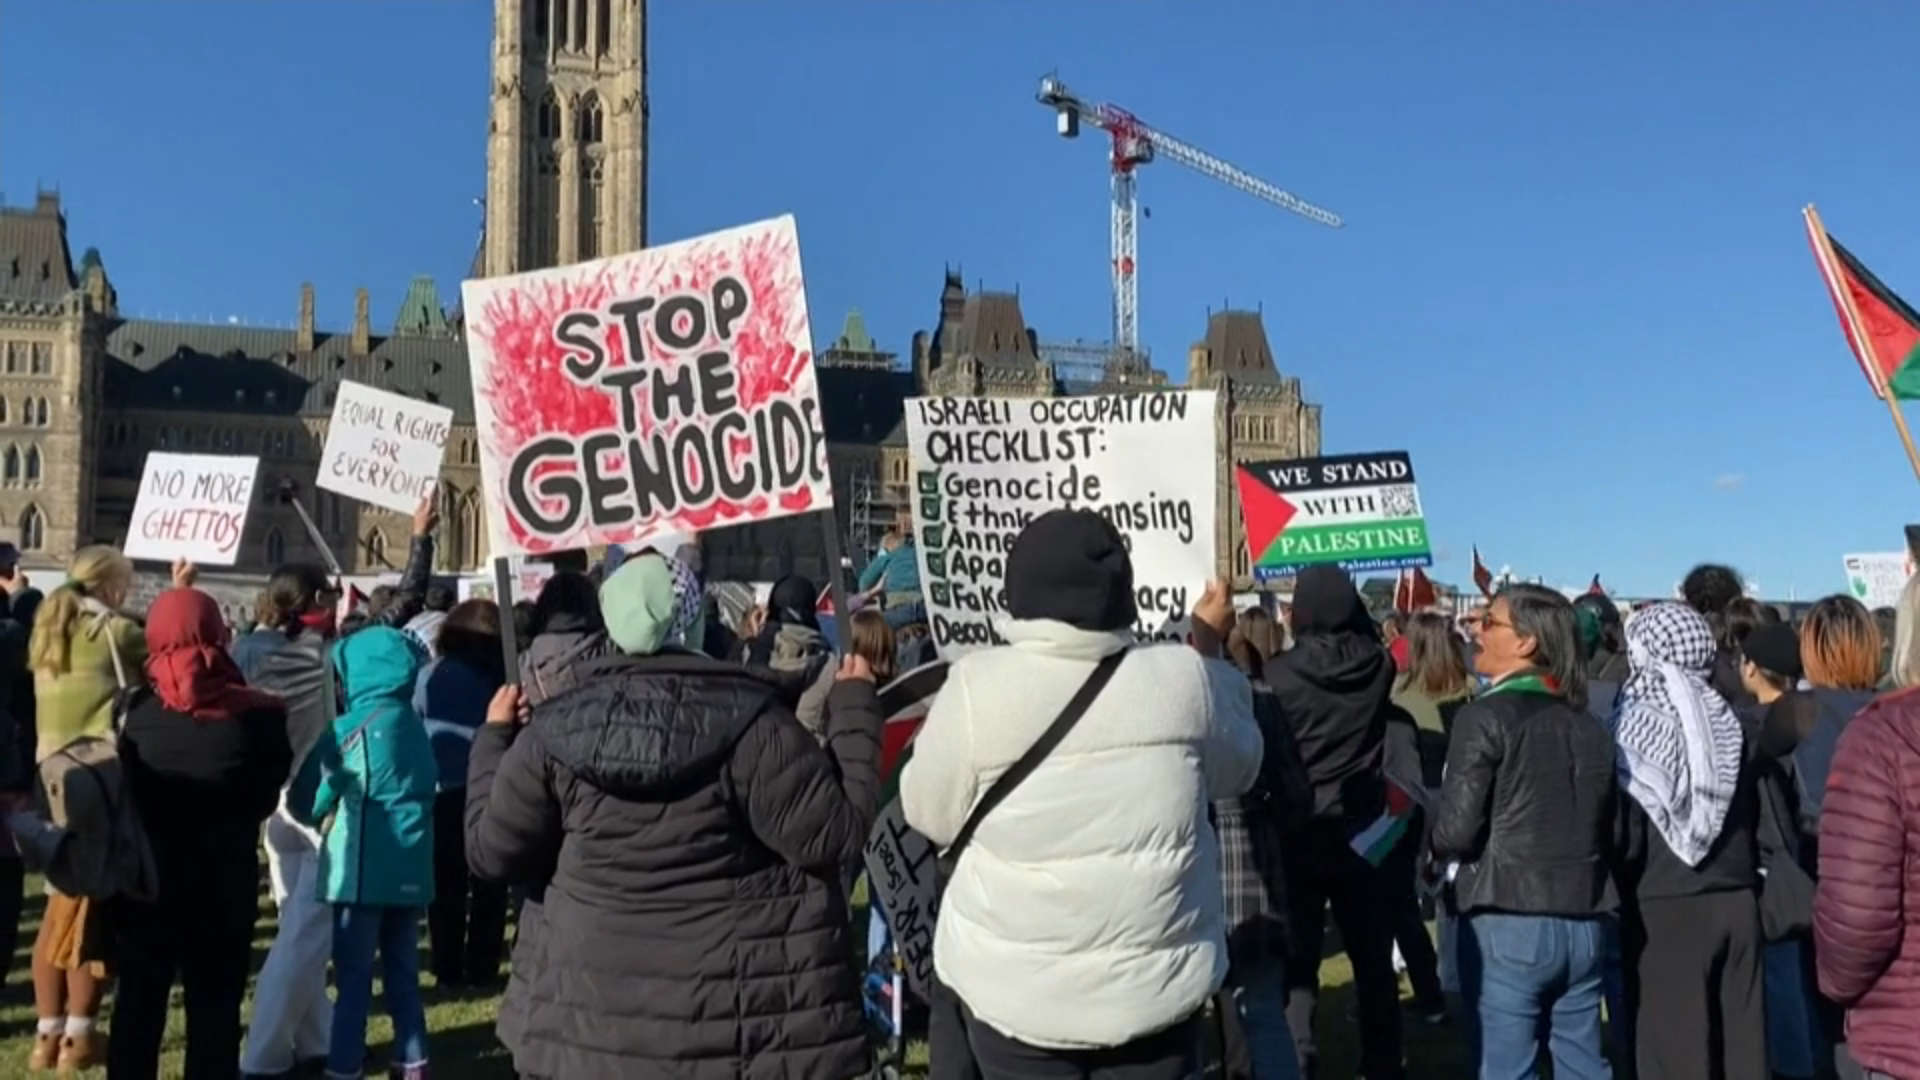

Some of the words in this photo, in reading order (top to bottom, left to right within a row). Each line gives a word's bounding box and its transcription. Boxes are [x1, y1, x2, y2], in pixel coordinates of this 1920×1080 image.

[556, 277, 748, 381] STOP
[602, 351, 738, 433] THE
[918, 400, 1011, 426] ISRAELI
[1029, 393, 1188, 424] OCCUPATION
[341, 398, 385, 430] EQUAL
[393, 410, 448, 448] RIGHTS
[369, 437, 401, 463] FOR
[926, 426, 1107, 464] CHECKLIST:
[331, 451, 436, 499] EVERYONE
[508, 398, 824, 534] GENOCIDE
[944, 464, 1102, 501] Genocide
[1268, 466, 1312, 487] WE
[1322, 459, 1408, 484] STAND
[149, 468, 184, 500] NO
[191, 471, 252, 505] MORE
[1302, 494, 1376, 517] WITH
[141, 507, 244, 554] GHETTOS
[1064, 491, 1193, 544] ansing
[1280, 525, 1423, 556] PALESTINE
